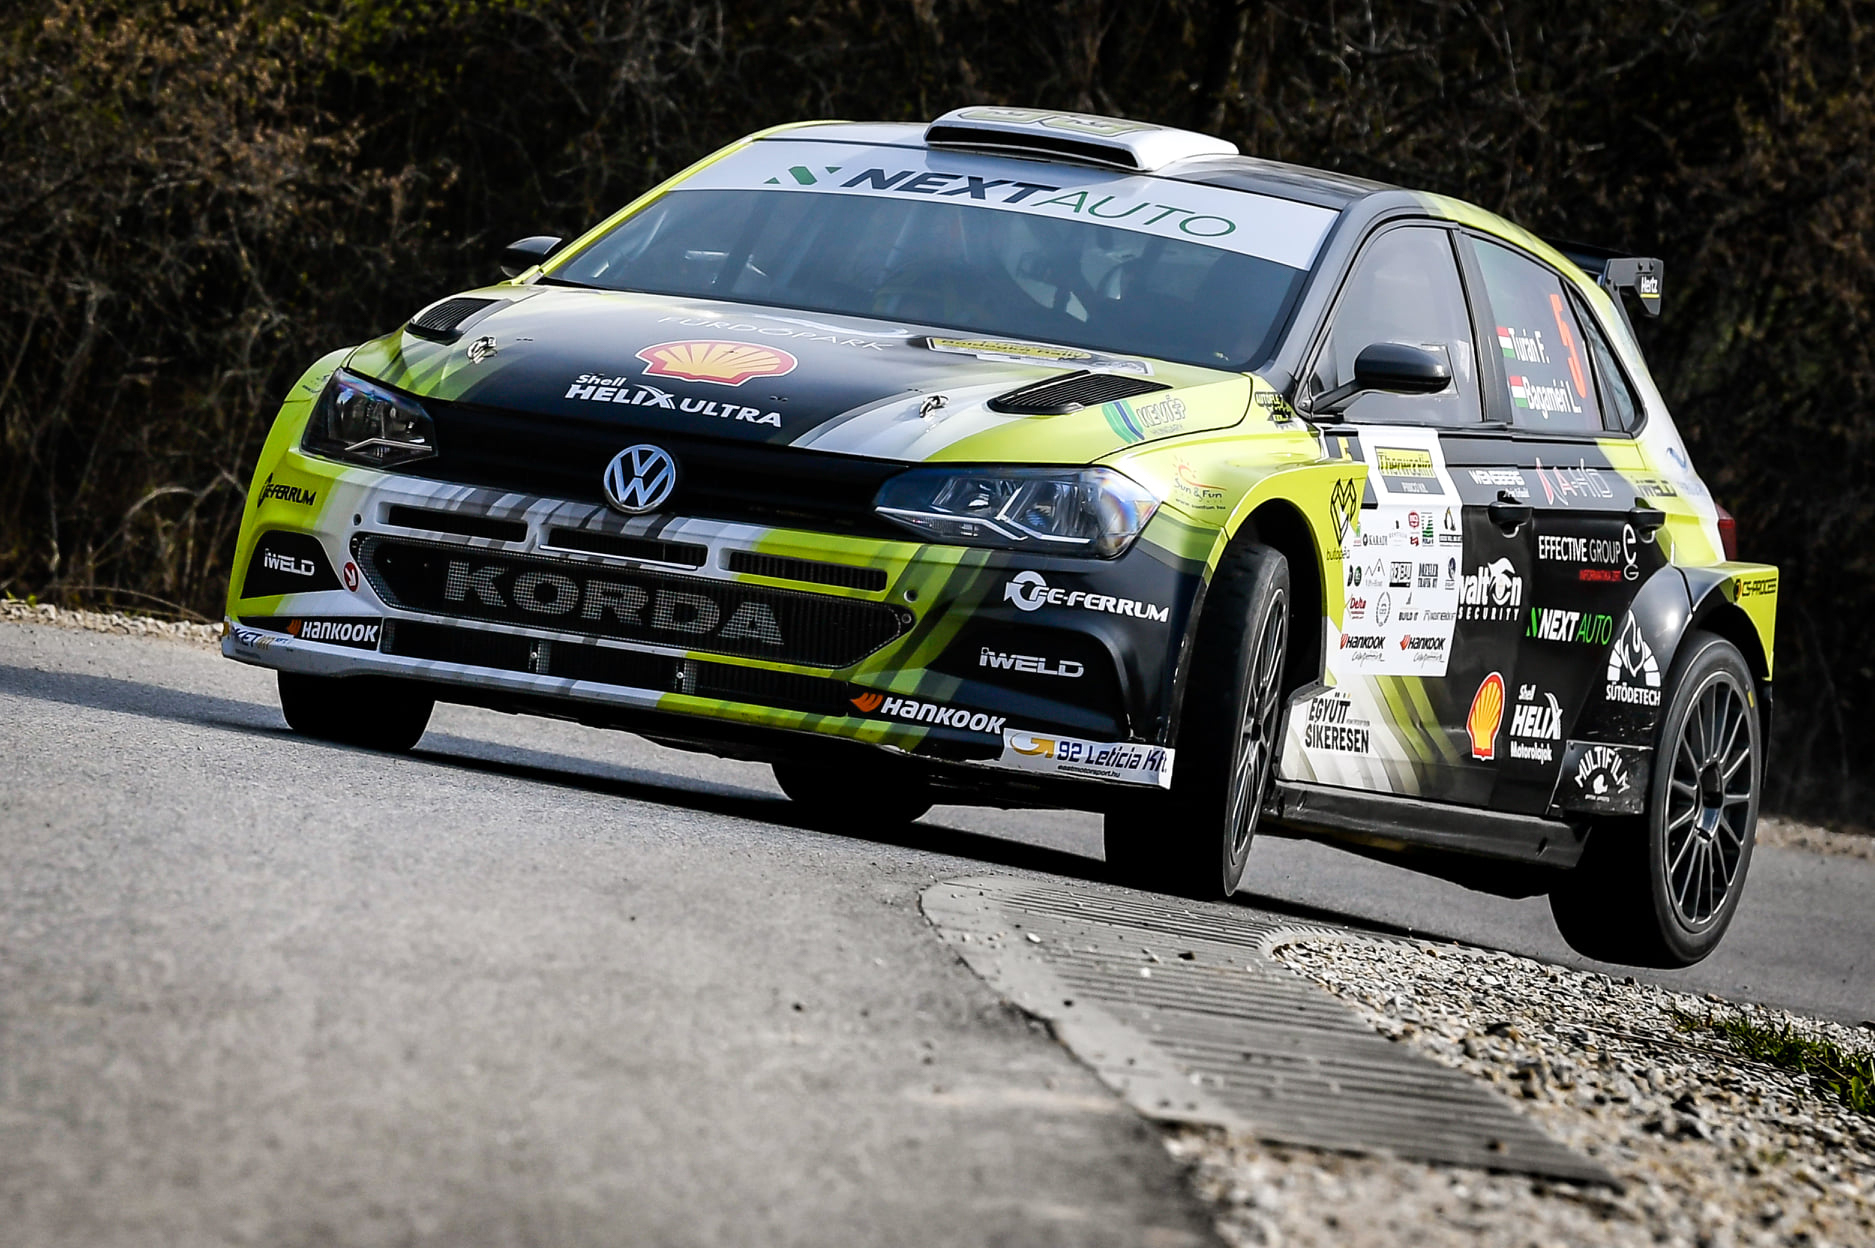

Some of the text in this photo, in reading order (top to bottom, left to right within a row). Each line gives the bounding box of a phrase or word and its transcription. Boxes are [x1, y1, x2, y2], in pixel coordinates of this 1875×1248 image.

[1641, 276, 1658, 293] Hertz
[1508, 327, 1550, 364] Turán F.
[575, 373, 626, 387] Shell
[565, 383, 782, 428] HELIX ULTRA
[1522, 376, 1571, 419] Bagaméri
[1175, 477, 1191, 495] Sun
[1202, 489, 1223, 499] Fun
[1538, 535, 1621, 564] EFFECTIVE GROUP
[444, 560, 786, 646] KORDA
[1458, 606, 1520, 622] SECURITY
[1518, 684, 1537, 701] Shell
[1510, 693, 1563, 740] HELIX
[1056, 740, 1084, 764] 92
[1305, 723, 1369, 754] SIKERESEN
[1510, 741, 1552, 765] Motorolajok
[1574, 746, 1631, 795] MULTIFILM
